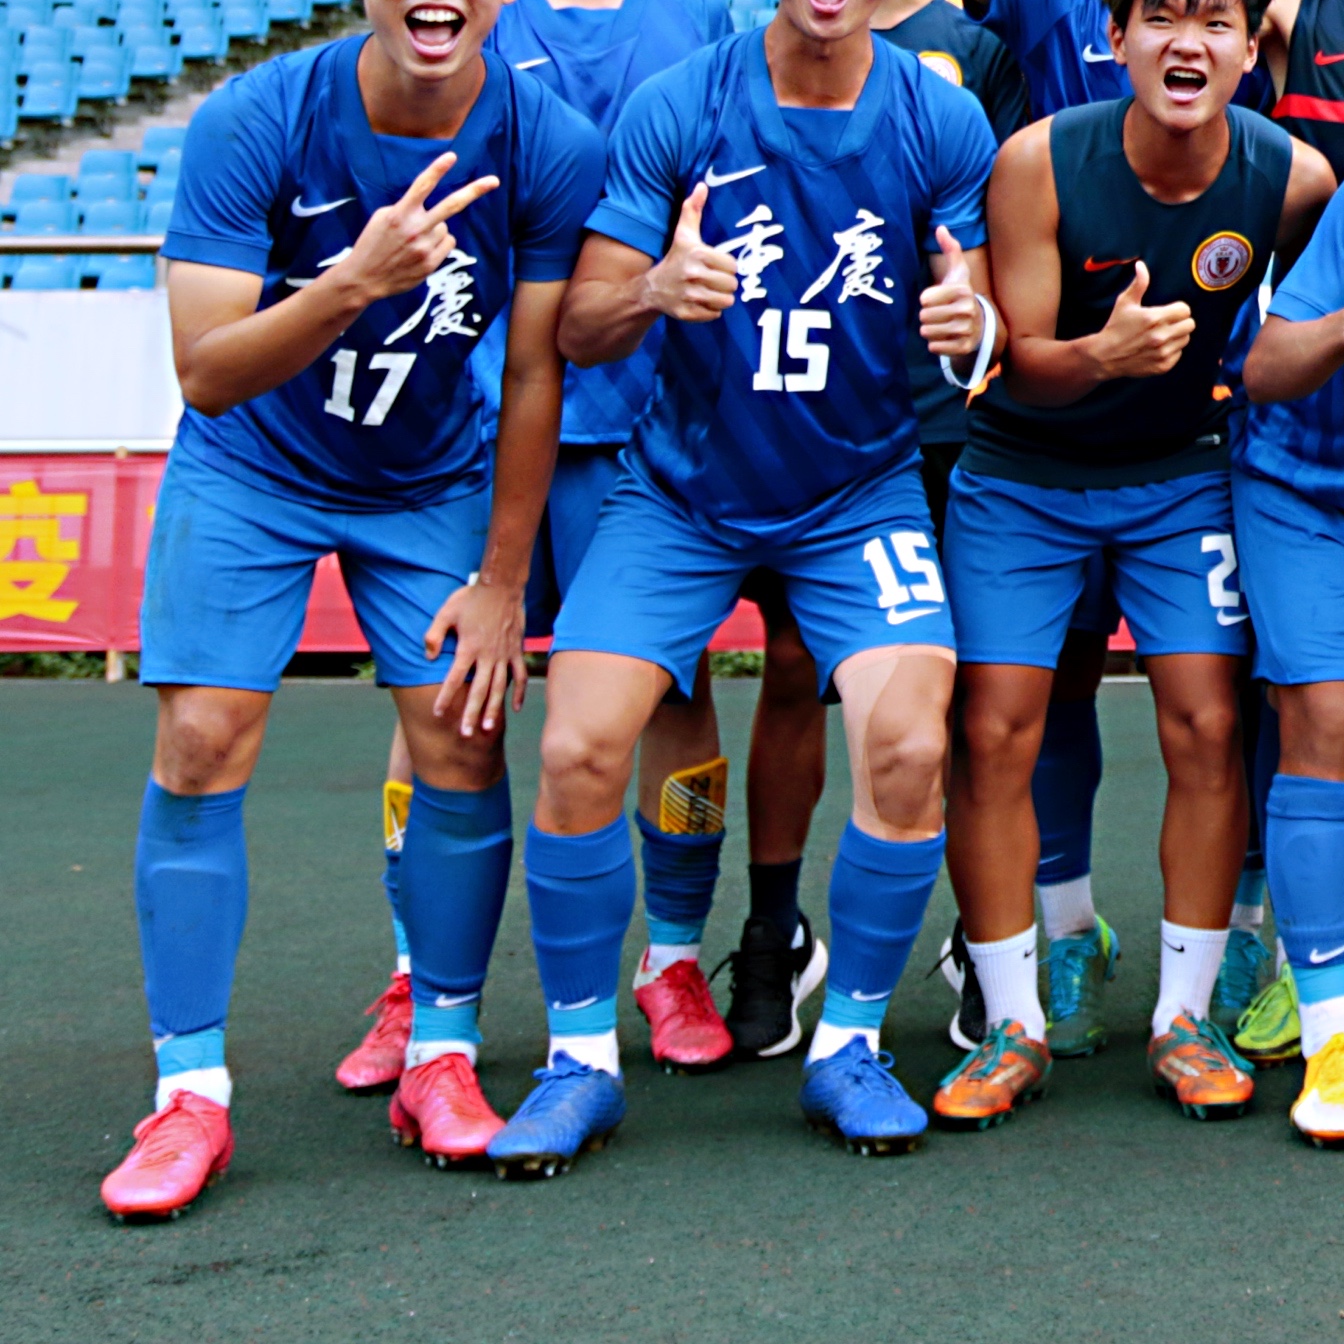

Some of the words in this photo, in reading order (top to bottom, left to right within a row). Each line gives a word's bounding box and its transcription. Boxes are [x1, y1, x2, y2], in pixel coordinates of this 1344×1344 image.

[285, 247, 483, 346] 慶
[324, 349, 418, 427] 17
[753, 308, 832, 393] 15
[863, 530, 945, 609] 15
[1201, 533, 1238, 607] 2
